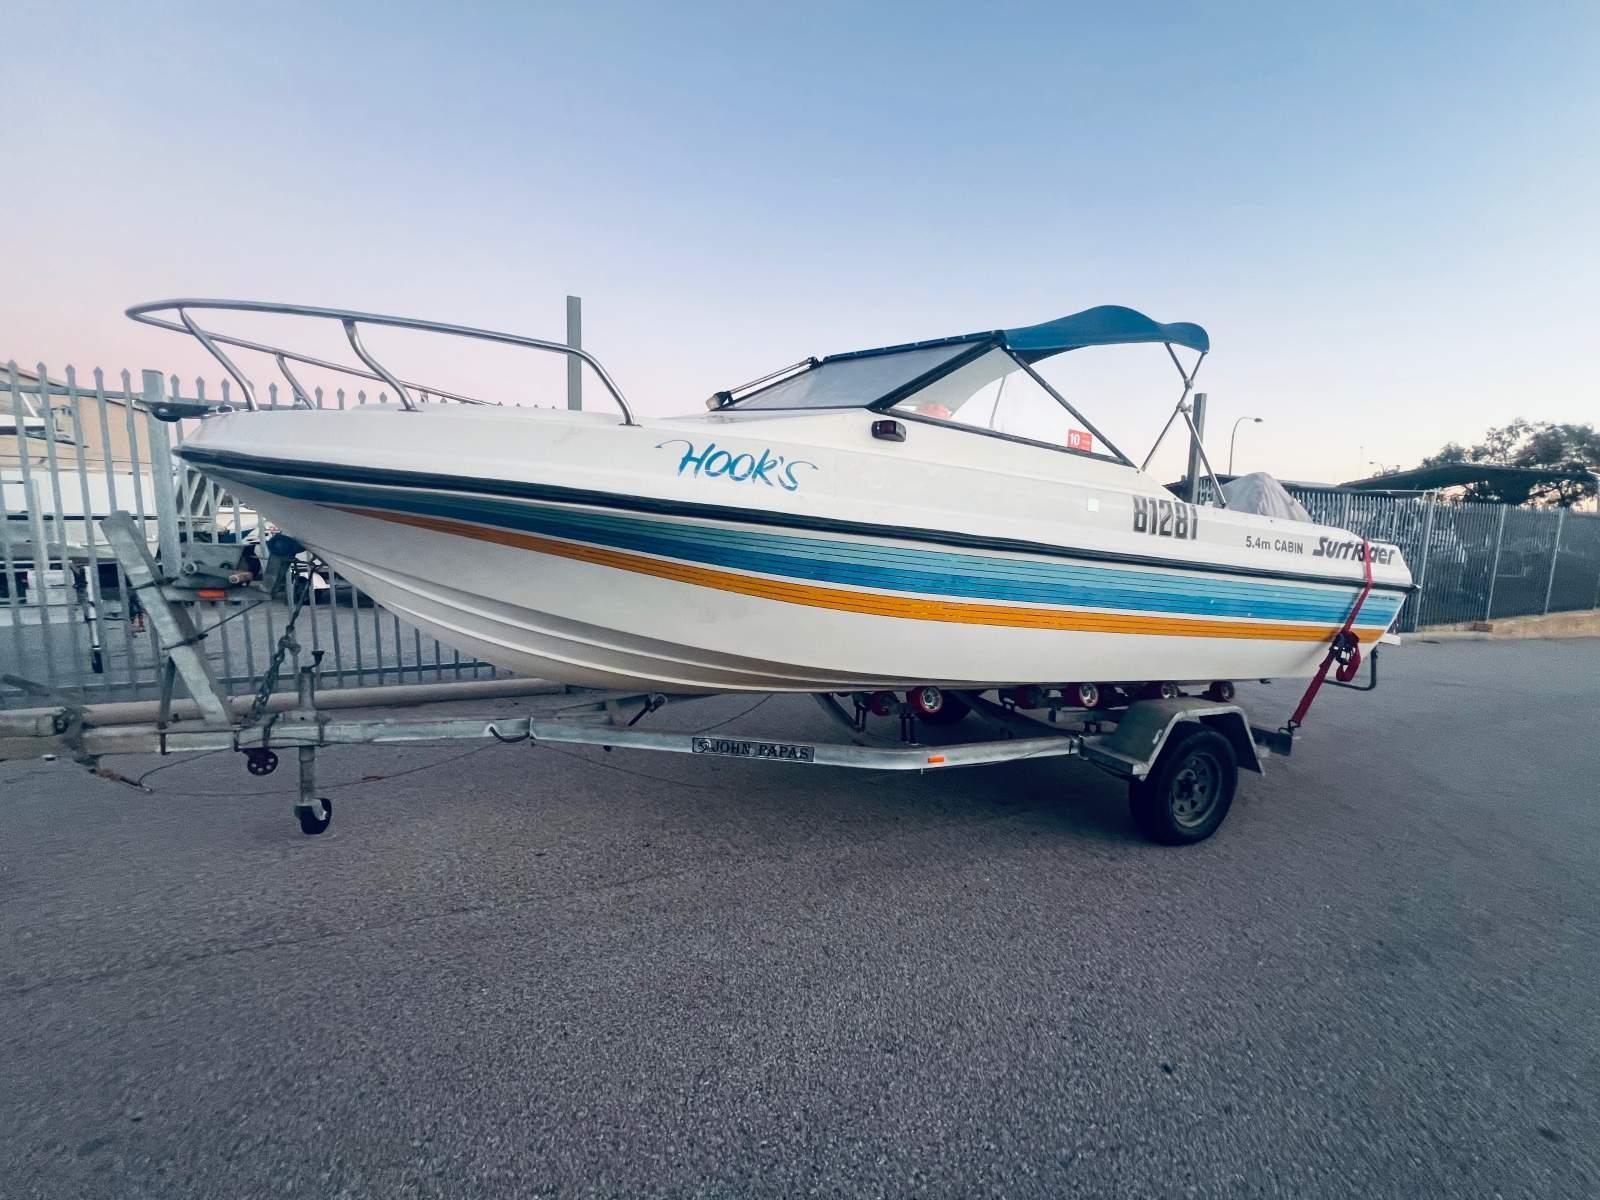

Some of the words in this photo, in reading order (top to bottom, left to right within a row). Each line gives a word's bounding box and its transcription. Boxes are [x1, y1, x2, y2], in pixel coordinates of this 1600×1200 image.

[1070, 433, 1080, 446] 10
[1245, 535, 1271, 551] 5.4m
[1274, 538, 1304, 555] CABIN
[710, 741, 751, 755] JOHN
[758, 744, 810, 760] PAPAS
